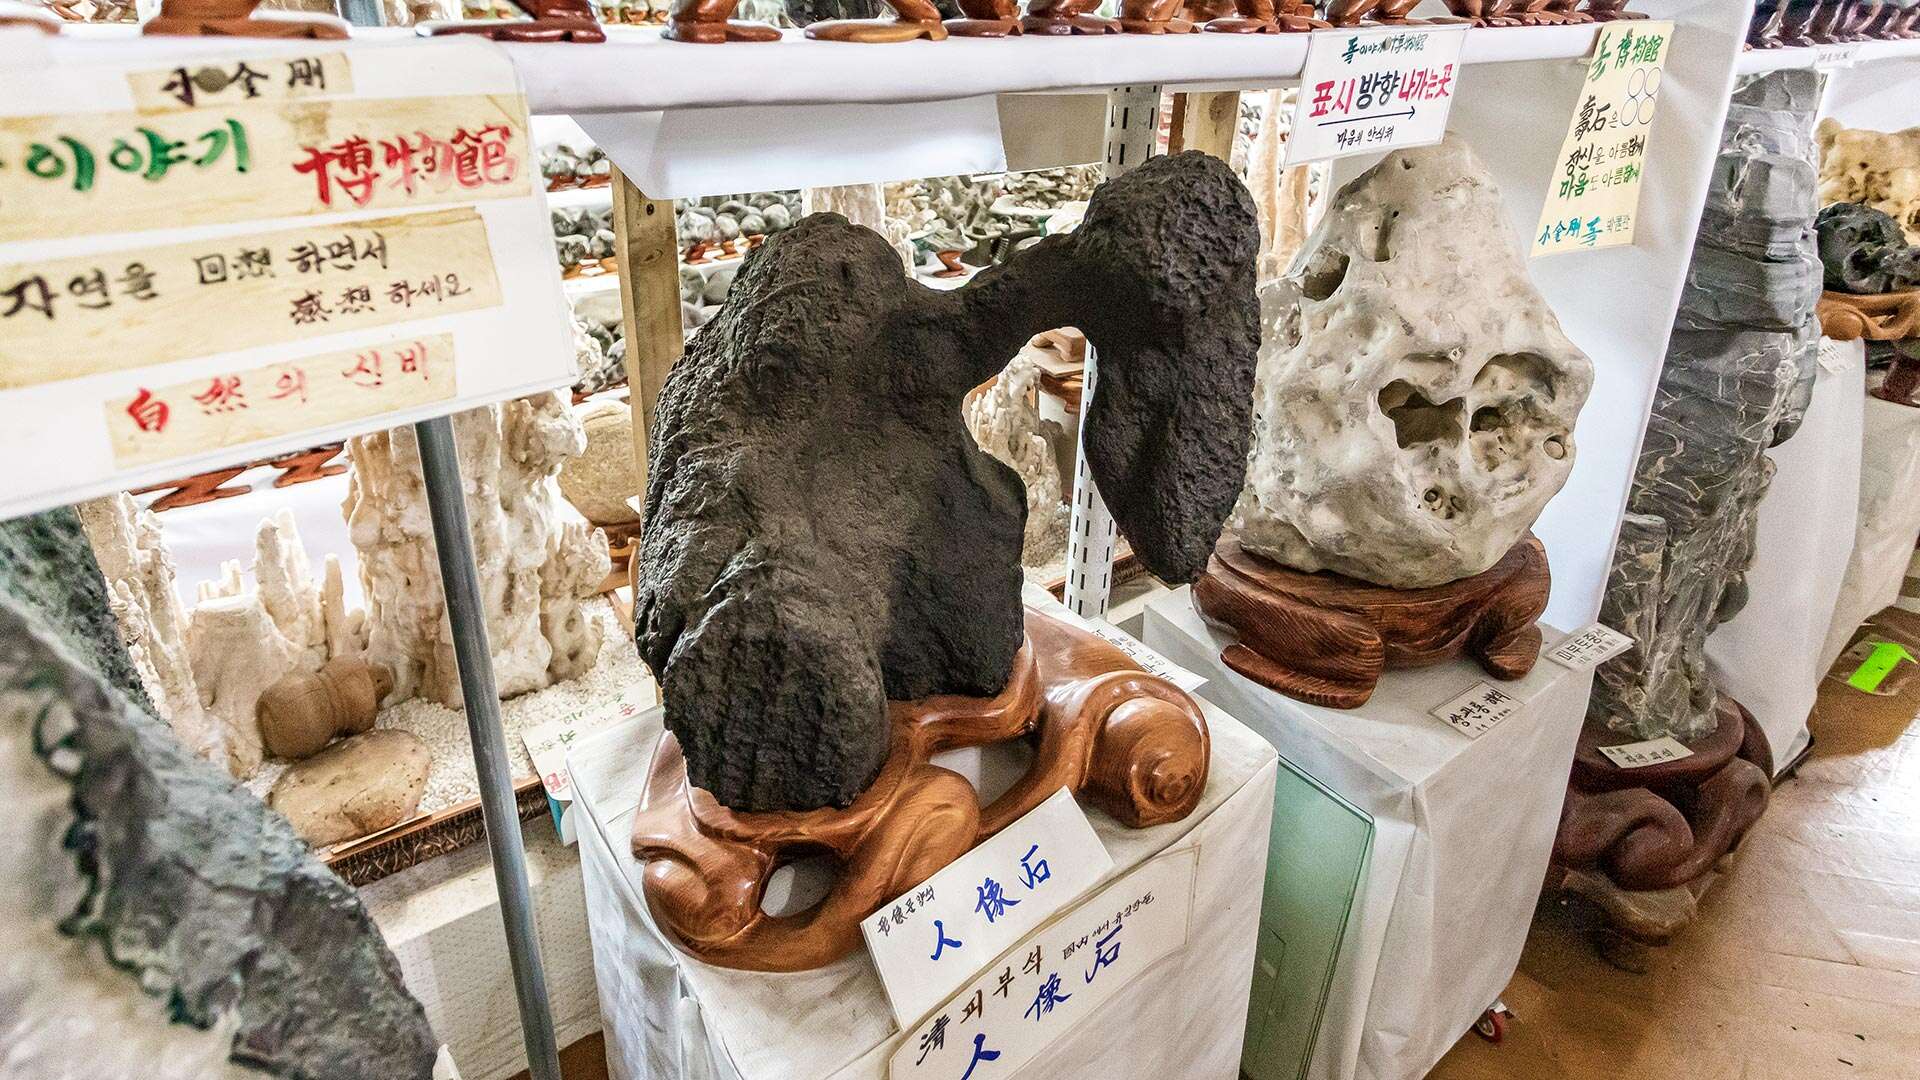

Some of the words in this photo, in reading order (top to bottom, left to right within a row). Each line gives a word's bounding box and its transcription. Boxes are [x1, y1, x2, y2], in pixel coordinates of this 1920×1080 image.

[1309, 78, 1356, 118] 표시
[1356, 70, 1401, 110] 방향
[1559, 171, 1599, 201] 마음도
[0, 262, 159, 320] 자연을
[288, 231, 388, 275] 하면서
[384, 273, 472, 308] 하세요
[342, 341, 429, 388] 신비
